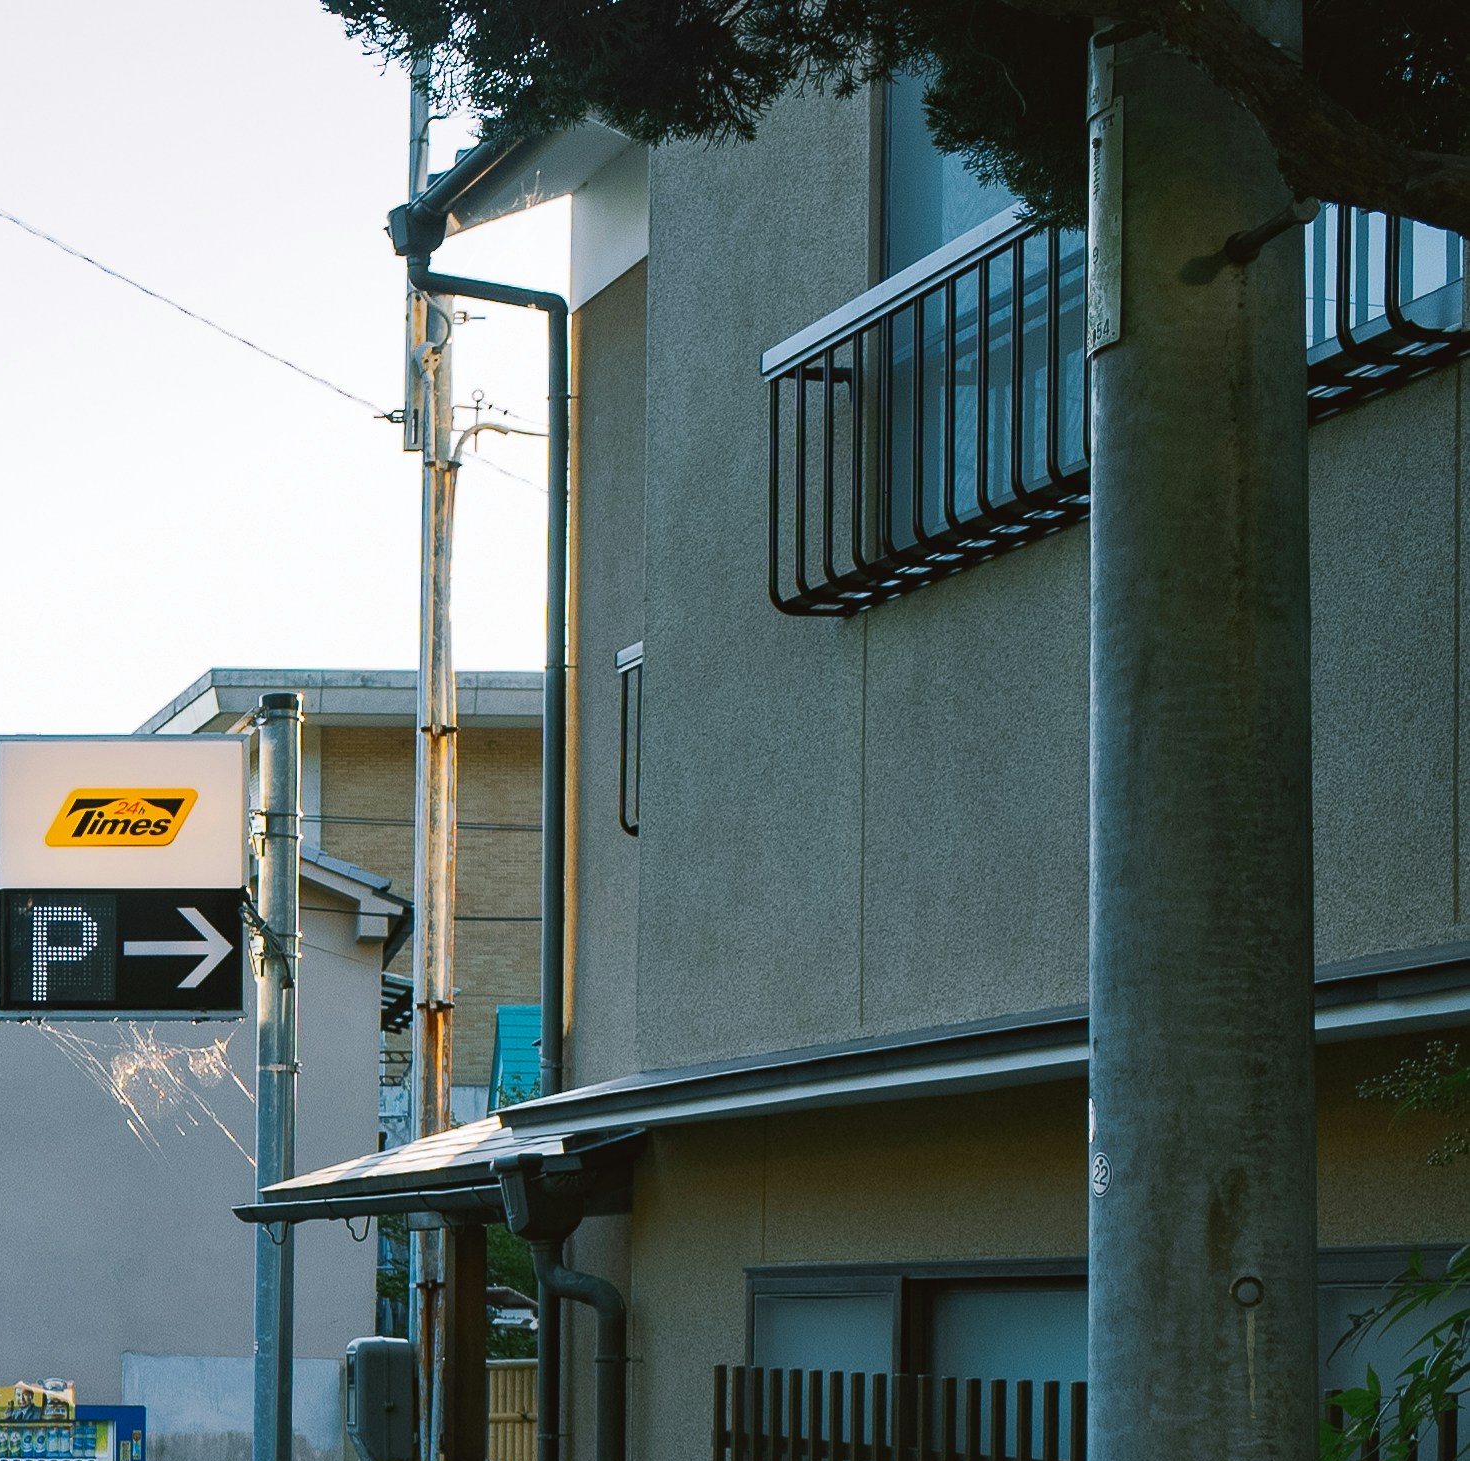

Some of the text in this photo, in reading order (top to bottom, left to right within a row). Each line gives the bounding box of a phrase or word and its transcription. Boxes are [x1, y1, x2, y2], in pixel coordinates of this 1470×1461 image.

[114, 801, 146, 815] 24h
[71, 810, 172, 837] Times
[32, 906, 99, 1002] P
[1093, 1164, 1109, 1186] 22
